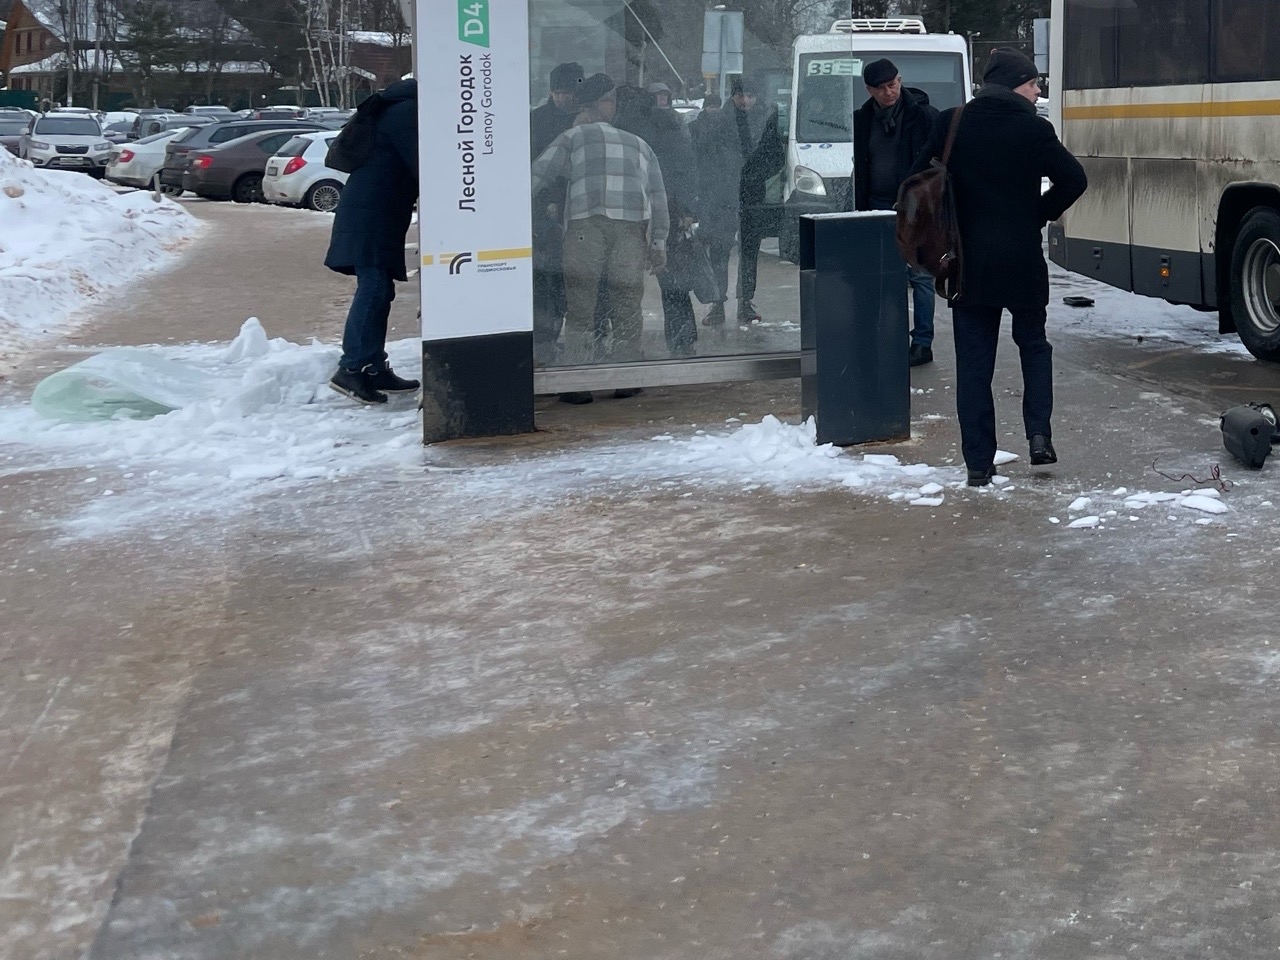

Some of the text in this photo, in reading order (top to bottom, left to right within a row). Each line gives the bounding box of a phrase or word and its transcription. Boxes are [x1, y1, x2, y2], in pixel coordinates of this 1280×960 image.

[463, 2, 484, 38] D4
[810, 62, 833, 75] 33
[457, 53, 478, 213] Лесной Городок
[479, 52, 496, 156] Lesnoy Gorodok
